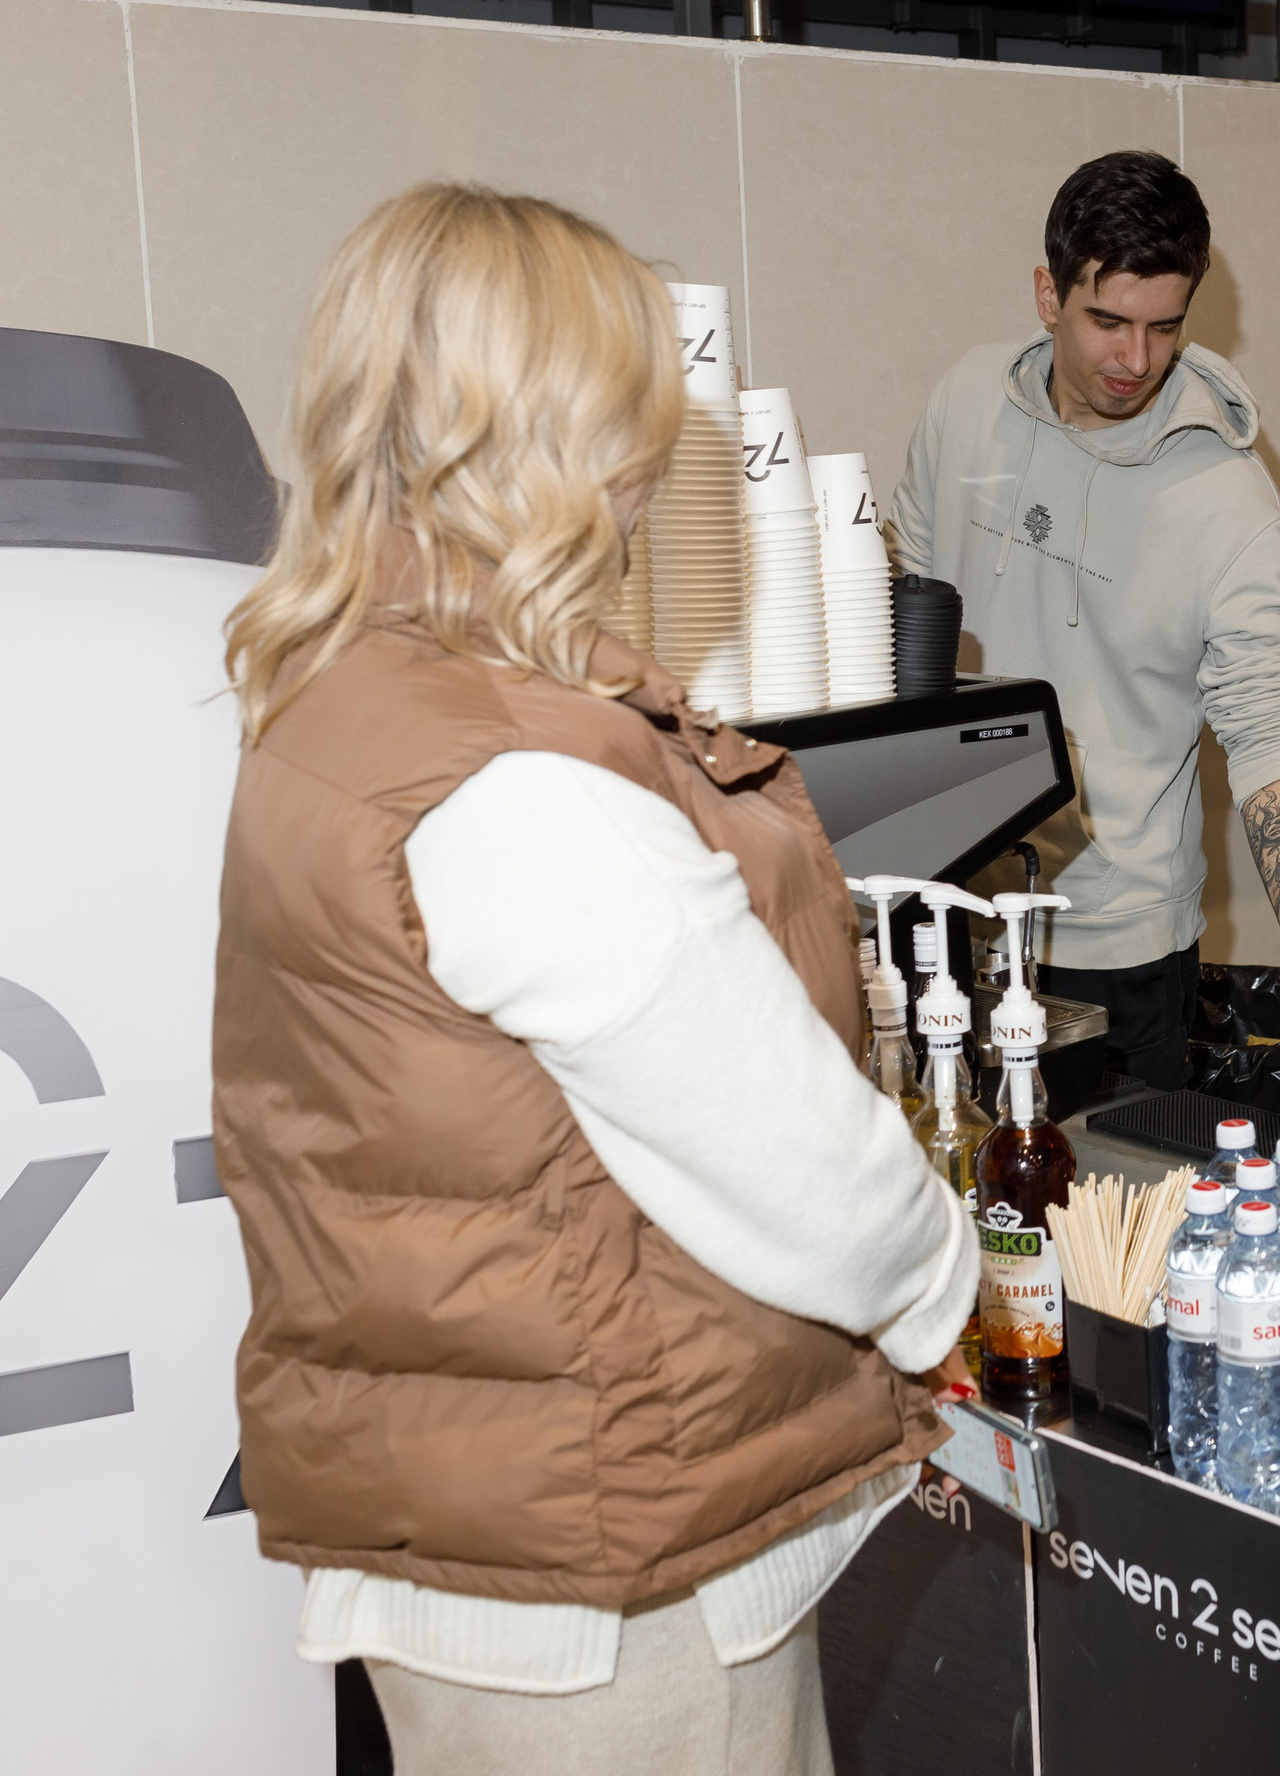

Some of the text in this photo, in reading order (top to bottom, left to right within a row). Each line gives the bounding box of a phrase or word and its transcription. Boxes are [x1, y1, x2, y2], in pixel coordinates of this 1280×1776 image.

[1011, 536, 1024, 546] TURE
[1046, 552, 1075, 567] ELEMENTS
[1098, 574, 1113, 584] PAST
[978, 730, 992, 739] KEX
[918, 1012, 963, 1027] ONIN
[980, 1228, 1038, 1255] ESKO
[997, 1283, 1054, 1298] CARAMEL
[908, 1483, 971, 1532] ven
[1049, 1530, 1179, 1620] seven
[1190, 1577, 1220, 1637] 2
[1155, 1623, 1258, 1682] COFFEE
